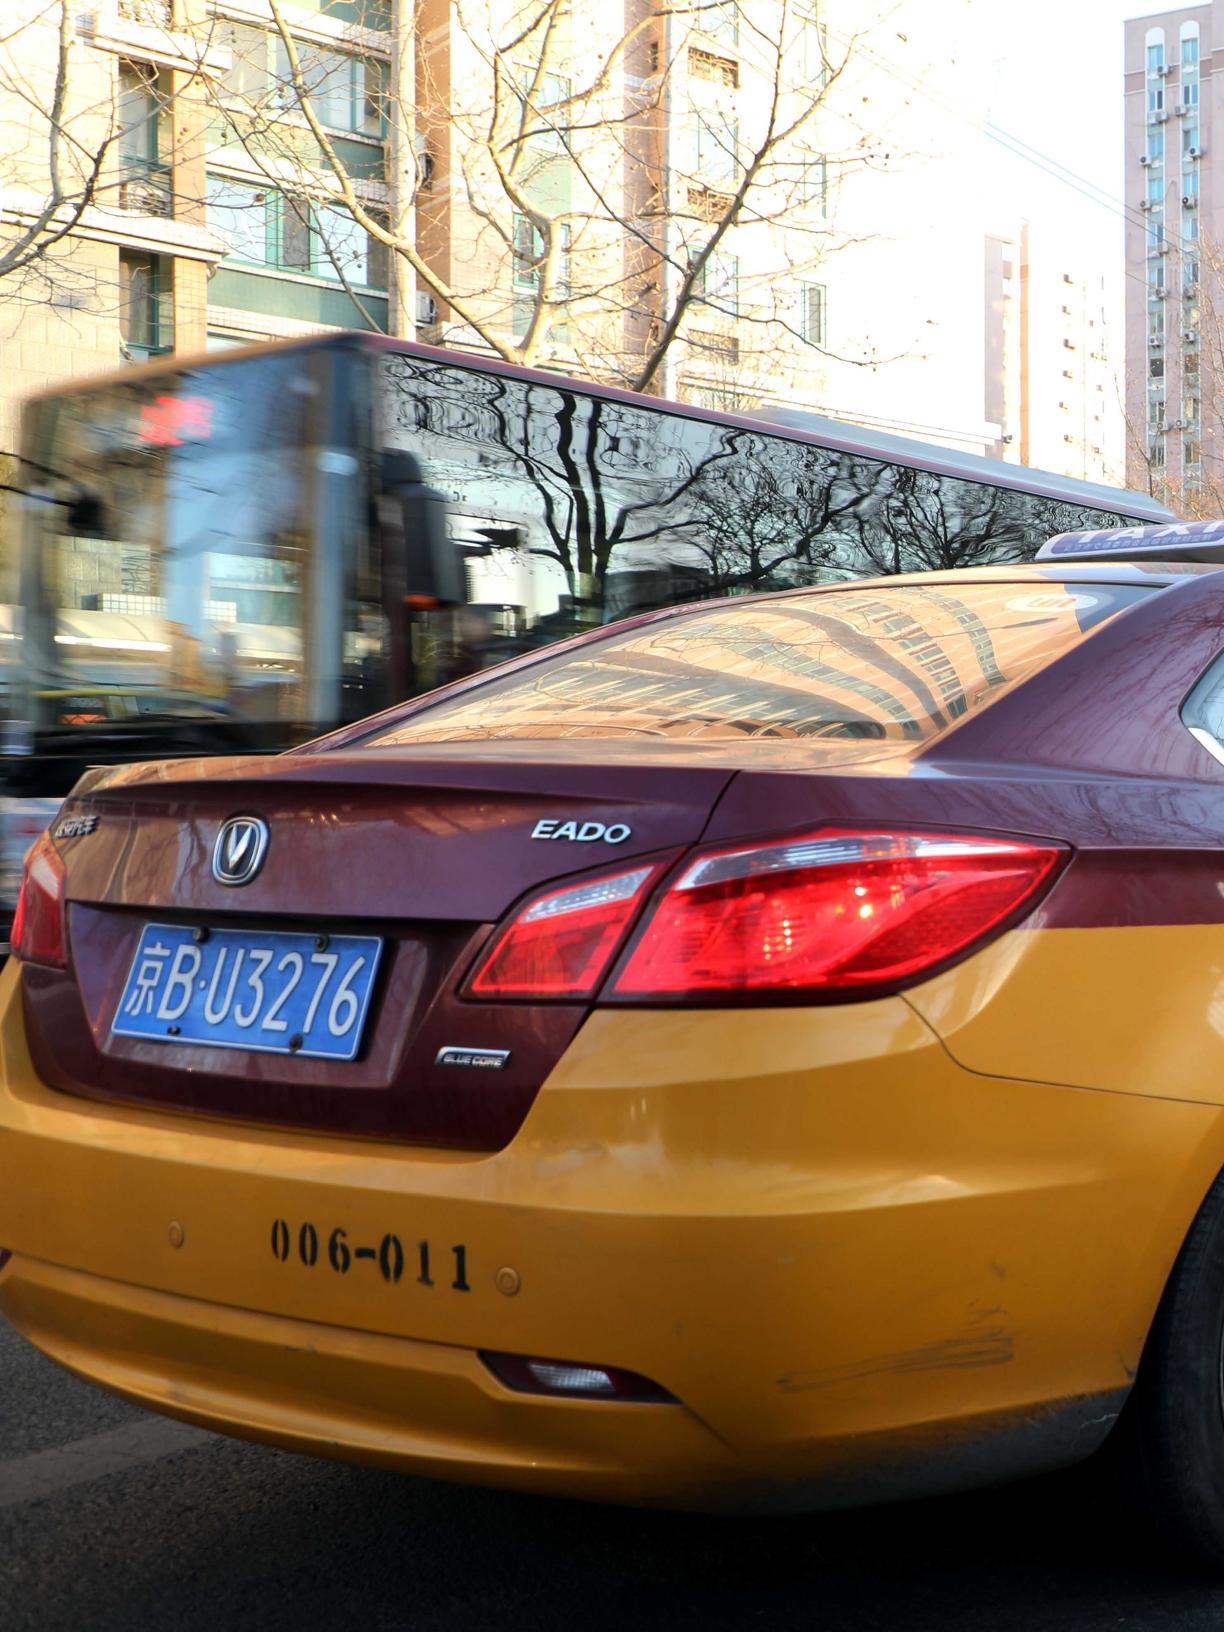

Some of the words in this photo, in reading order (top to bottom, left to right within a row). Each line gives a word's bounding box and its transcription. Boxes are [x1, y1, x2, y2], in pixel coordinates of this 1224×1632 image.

[1075, 520, 1223, 544] TAXI
[530, 819, 632, 844] EADO
[271, 1219, 471, 1292] 006-011
